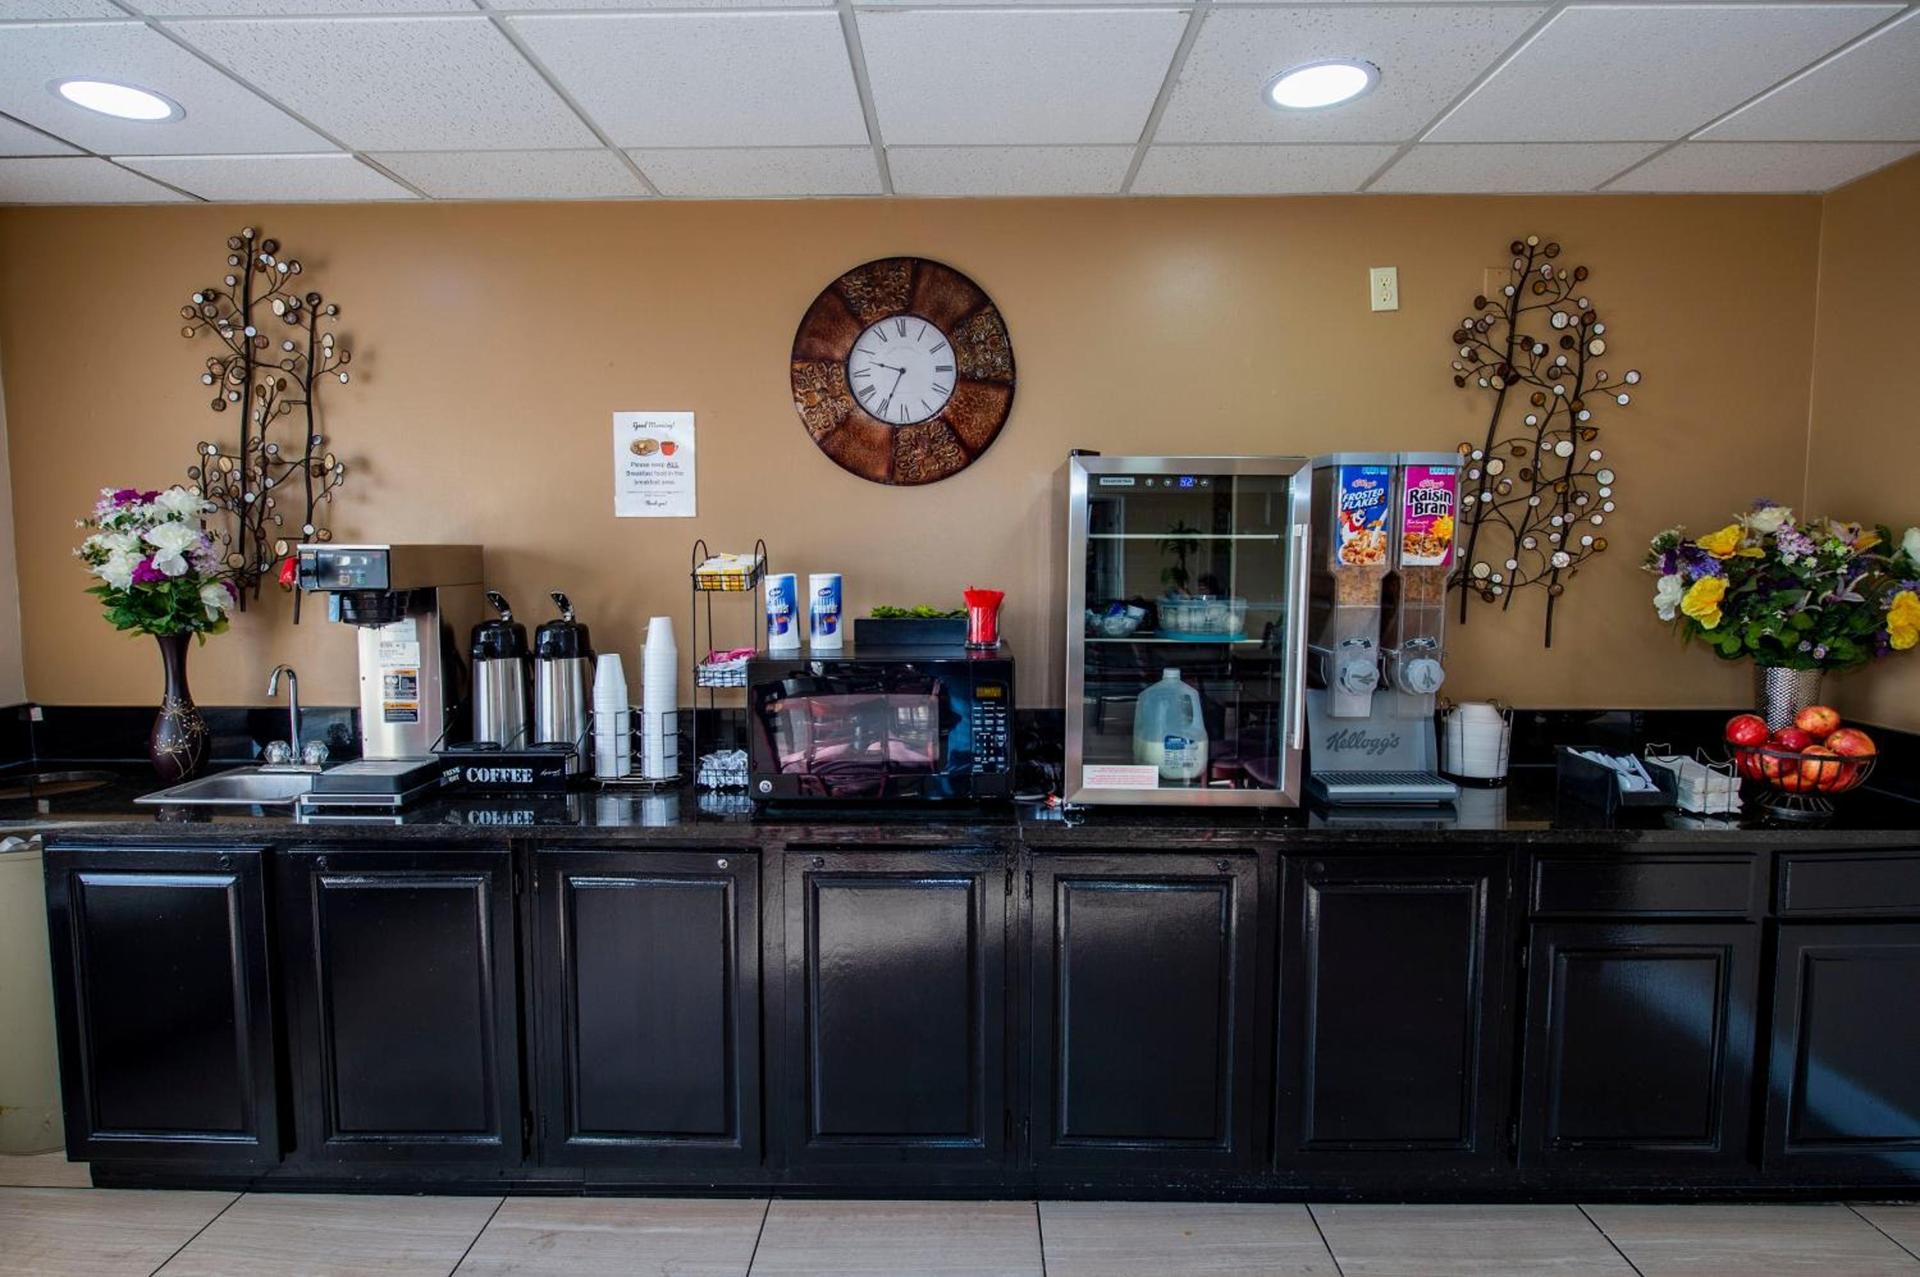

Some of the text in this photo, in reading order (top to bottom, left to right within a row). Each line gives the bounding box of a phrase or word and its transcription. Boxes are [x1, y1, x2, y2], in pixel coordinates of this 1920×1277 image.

[1342, 488, 1384, 503] FROSTED
[1409, 488, 1452, 504] Raisin
[1343, 497, 1379, 510] FLAKES
[1414, 502, 1447, 515] Bran
[1326, 728, 1400, 755] Kellogg's
[466, 767, 533, 783] COFFEE
